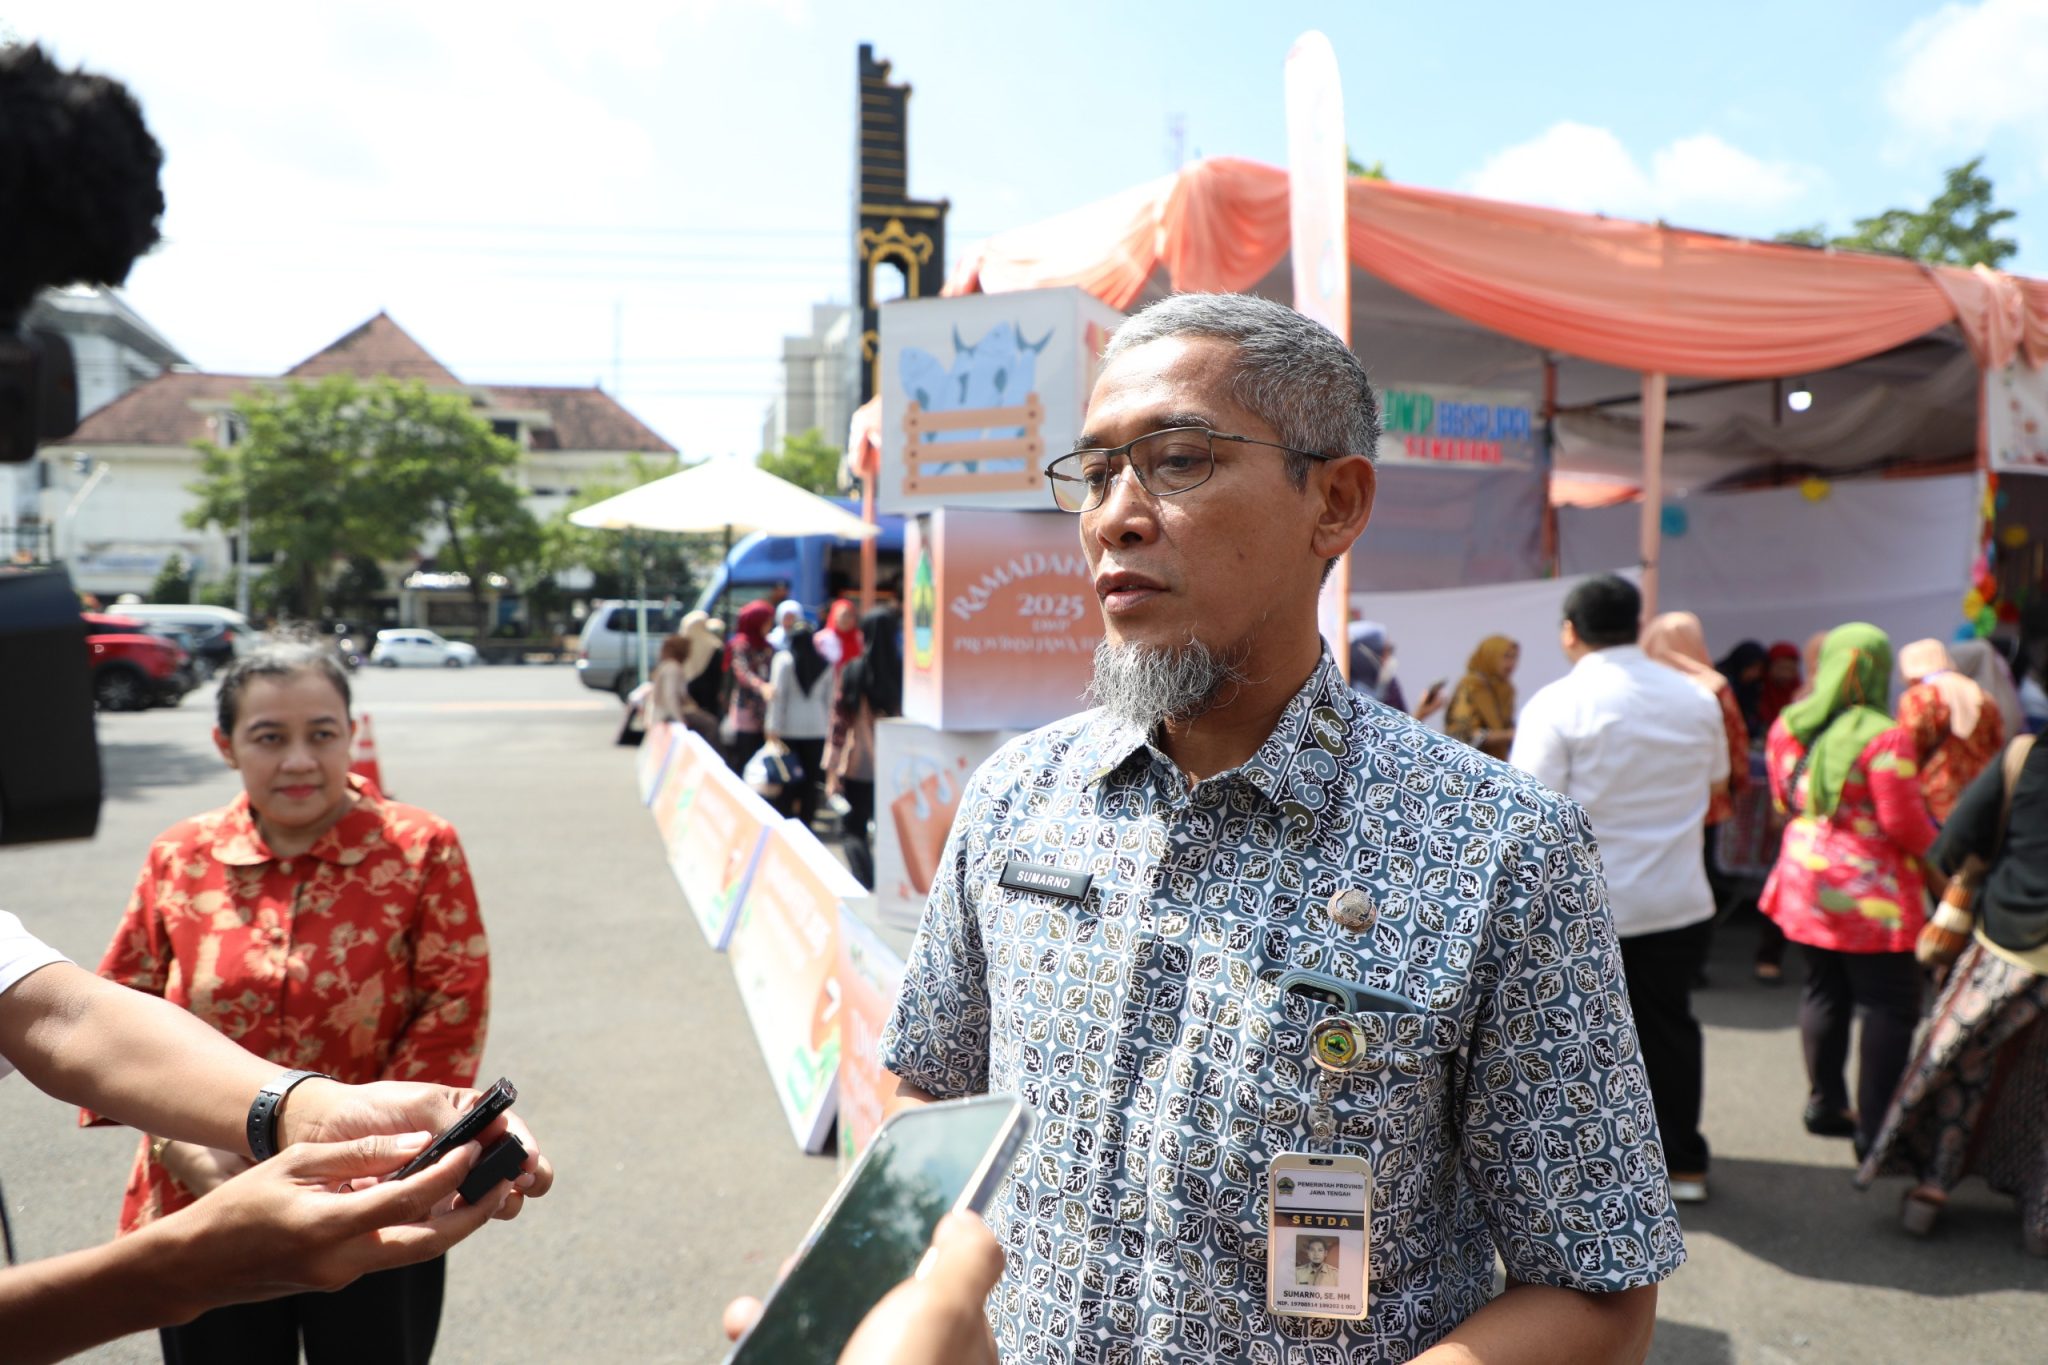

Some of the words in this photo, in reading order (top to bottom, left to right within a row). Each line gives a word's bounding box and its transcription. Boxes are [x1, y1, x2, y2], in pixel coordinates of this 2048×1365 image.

[951, 552, 1087, 621] RAMADAN
[1018, 593, 1086, 620] 2025
[1017, 871, 1070, 888] SUMARNO
[1297, 1181, 1335, 1189] PEMERINTAH
[1292, 1215, 1350, 1228] SETDA
[1283, 1290, 1322, 1300] SUMARNO,
[1337, 1293, 1350, 1301] MM
